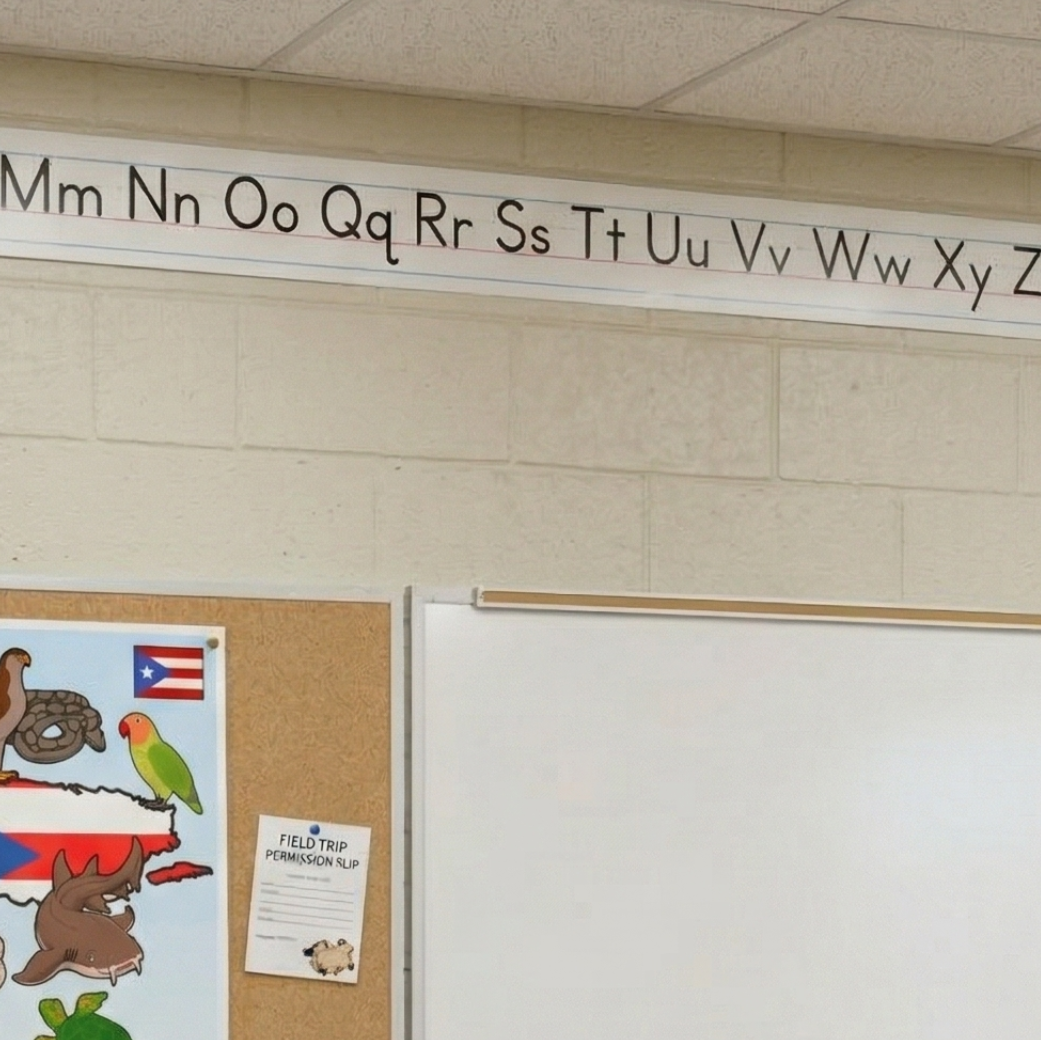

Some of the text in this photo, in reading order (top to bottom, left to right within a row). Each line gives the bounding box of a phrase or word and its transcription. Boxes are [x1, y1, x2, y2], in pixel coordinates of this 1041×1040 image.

[0, 153, 102, 218] Mm
[128, 164, 200, 226] Nn
[224, 175, 299, 233] Oo
[320, 184, 400, 266] Qq
[416, 191, 474, 250] Rr
[496, 199, 551, 256] Ss
[570, 205, 626, 262] Tt
[646, 211, 710, 269] Uu
[730, 219, 792, 276] Vv
[812, 227, 912, 286] Ww
[933, 238, 993, 312] Xy
[280, 834, 348, 852] FIELD TRIP
[336, 857, 360, 869] SLIP
